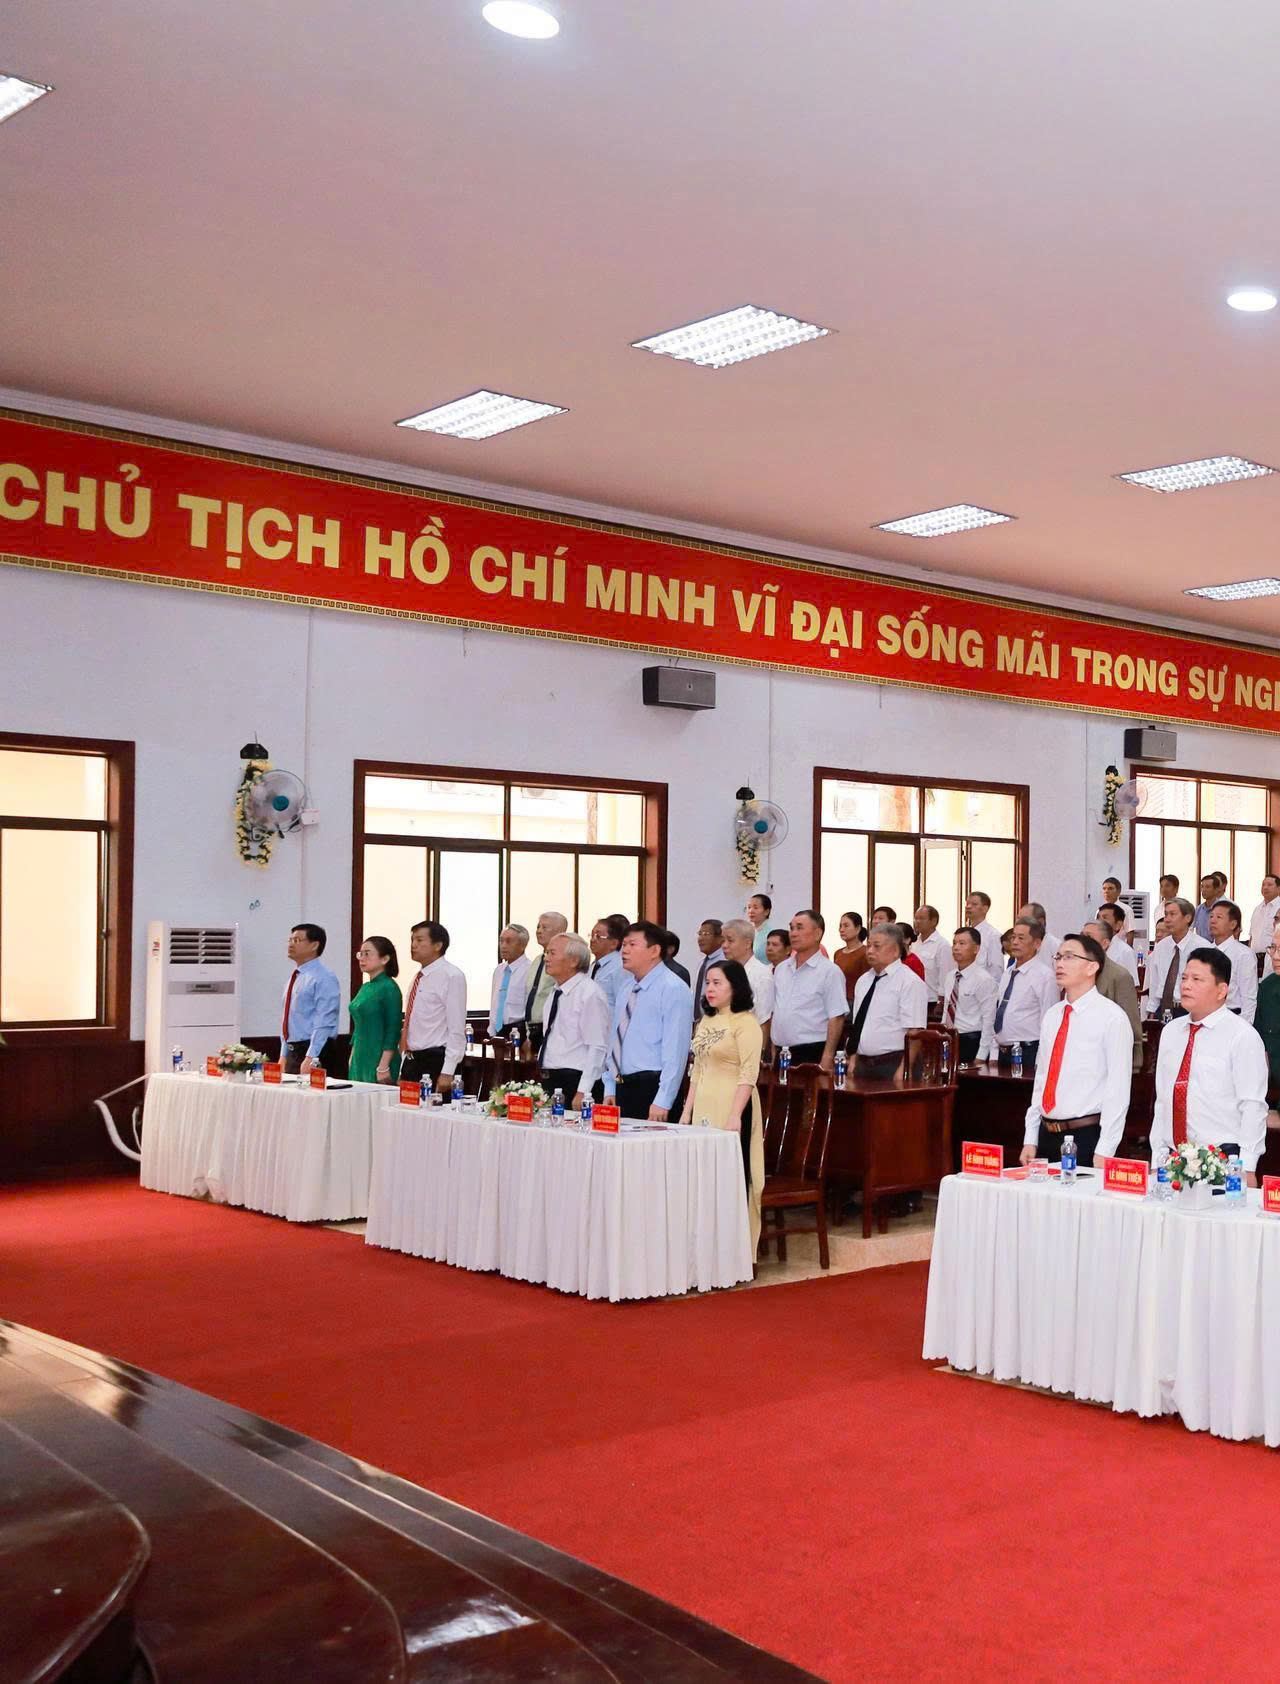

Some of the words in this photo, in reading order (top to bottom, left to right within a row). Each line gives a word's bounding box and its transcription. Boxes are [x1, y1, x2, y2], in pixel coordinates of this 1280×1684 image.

[0, 463, 151, 538] CHỦ
[178, 494, 341, 570] TỊCH
[364, 516, 450, 585] HỒ
[468, 546, 567, 605] CHÍ
[586, 564, 716, 628] MINH
[731, 582, 777, 637] VĨ
[790, 601, 863, 660] ĐẠI
[877, 602, 984, 669] SỐNG
[996, 630, 1060, 682] MÃI
[1071, 647, 1180, 698] TRONG
[1189, 664, 1229, 712] SỰ
